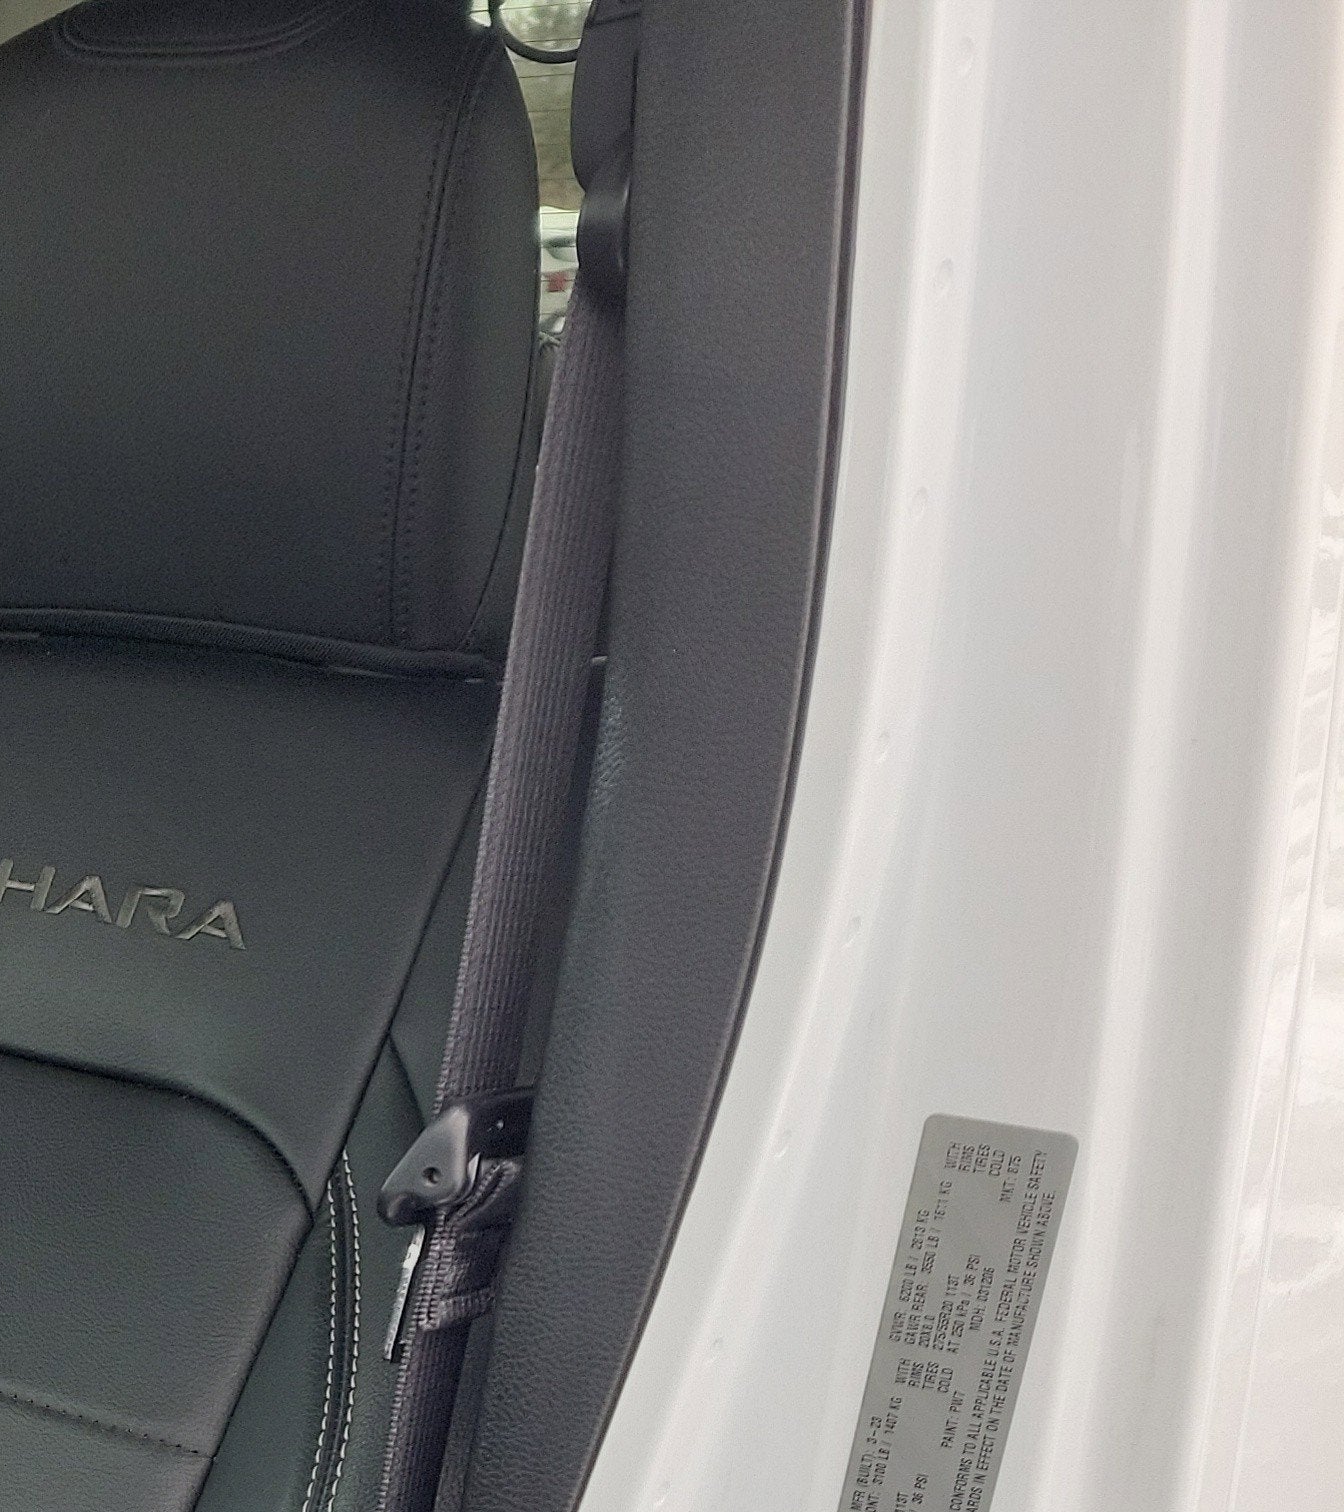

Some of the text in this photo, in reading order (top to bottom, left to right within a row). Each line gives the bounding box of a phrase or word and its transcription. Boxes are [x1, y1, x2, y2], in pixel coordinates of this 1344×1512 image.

[973, 1143, 990, 1174] TIRES
[988, 1148, 1005, 1176] COLD
[1026, 1149, 1047, 1190] SAFETY
[1016, 1192, 1037, 1234] VEHICLE
[1006, 1237, 1026, 1273] MOTOR
[1026, 1229, 1046, 1267] SHOWN
[966, 1253, 980, 1270] PSI
[963, 1273, 975, 1285] 36
[994, 1276, 1017, 1322] FEDERAL
[1006, 1270, 1036, 1346] MANUFACTURE
[950, 1319, 965, 1337] 250
[946, 1340, 960, 1353] AT
[1003, 1349, 1016, 1362] OF
[894, 1357, 911, 1384] WITH
[908, 1361, 924, 1387] RIMS
[922, 1360, 939, 1390] TIRES
[936, 1366, 953, 1393] COLD
[995, 1365, 1013, 1392] DATE
[971, 1358, 997, 1419] APPLICABLE
[888, 1395, 902, 1410] KG
[989, 1394, 1005, 1415] THE
[883, 1412, 898, 1434] 1407
[965, 1420, 981, 1439] ALL
[986, 1417, 999, 1431] ON
[876, 1447, 890, 1460] LB
[962, 1442, 976, 1455] TO
[976, 1434, 995, 1470] EFFECT
[871, 1462, 887, 1485] 3100
[914, 1472, 928, 1489] PSI
[948, 1457, 972, 1511] CONFORMS
[972, 1473, 986, 1484] IN
[850, 1489, 865, 1510] MFR
[911, 1492, 924, 1504] 36
